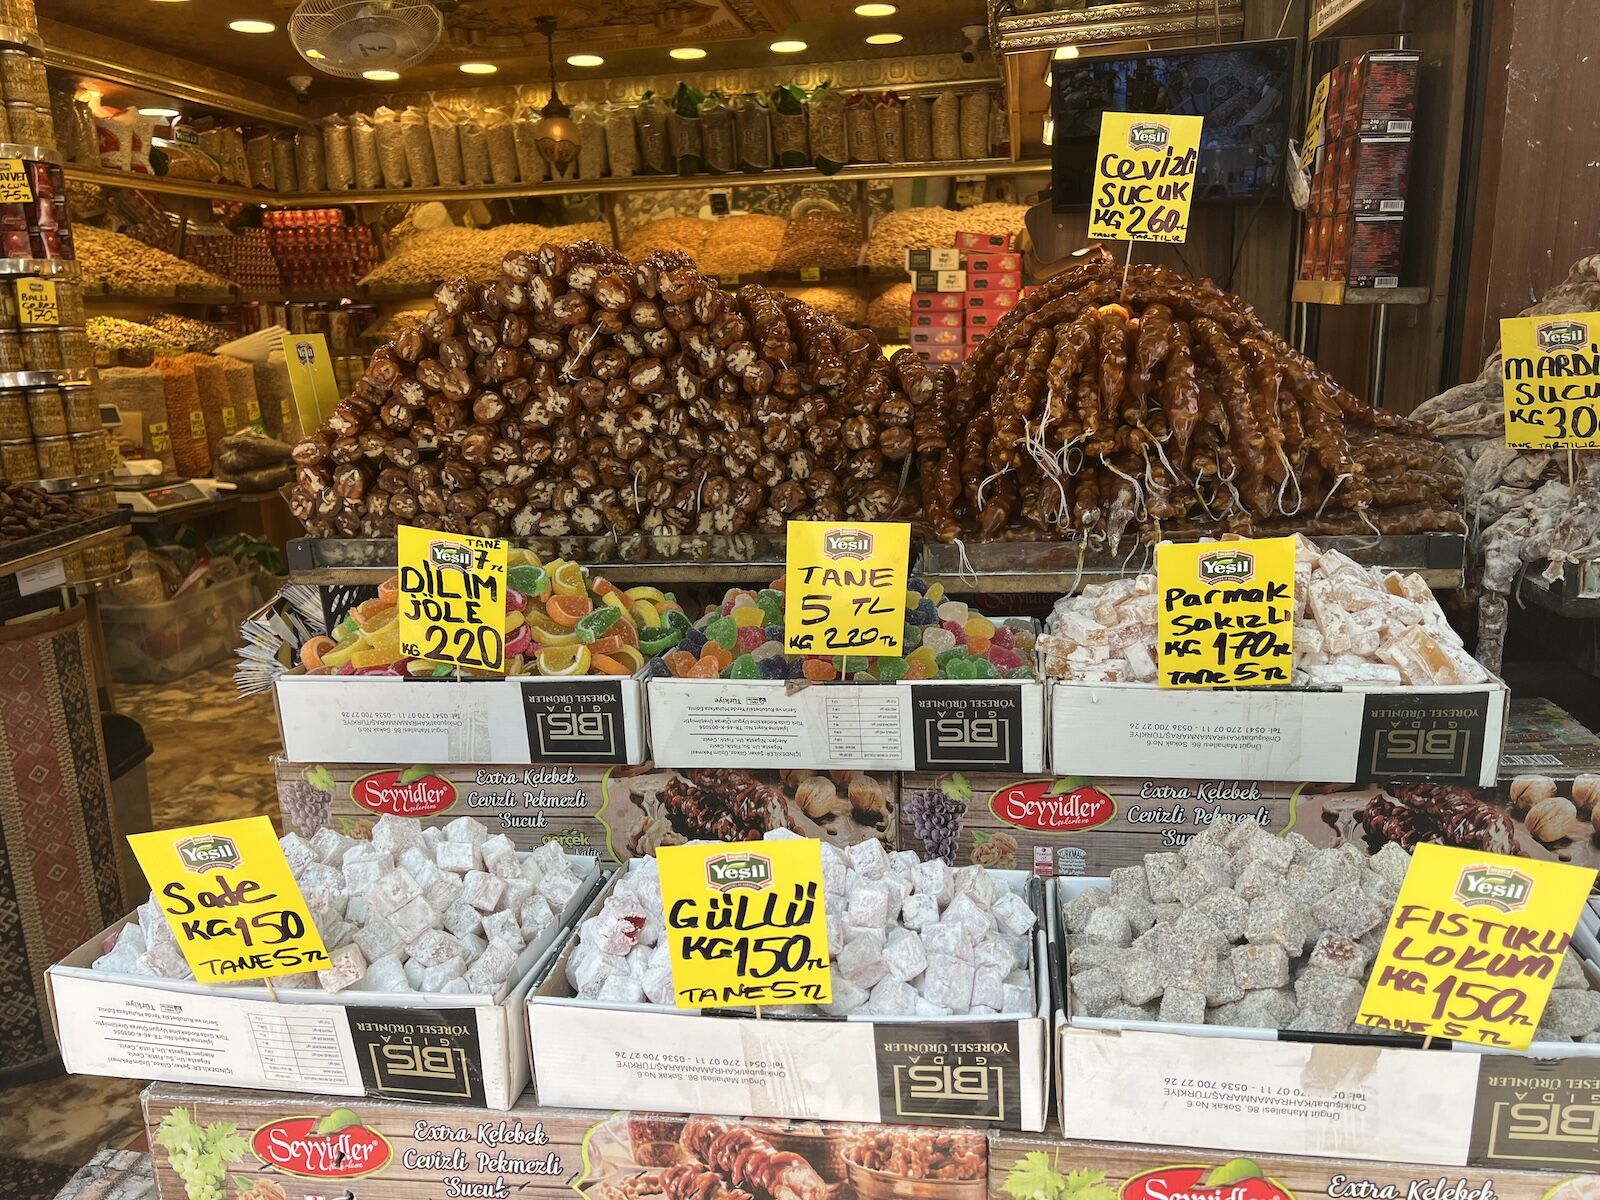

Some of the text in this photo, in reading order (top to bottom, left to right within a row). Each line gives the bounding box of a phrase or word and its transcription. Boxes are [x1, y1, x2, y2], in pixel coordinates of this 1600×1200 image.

[1133, 129, 1166, 143] Yeşil
[1101, 146, 1196, 180] Cevizli
[1094, 209, 1124, 229] KG
[1541, 330, 1582, 343] Yeşil
[1509, 406, 1600, 438] KG 30
[465, 539, 501, 549] TANE
[828, 537, 868, 551] Yeşil
[433, 547, 469, 564] Yeşil
[474, 550, 490, 569] 7
[798, 566, 894, 587] TANE
[1204, 561, 1249, 575] Yeşil
[801, 594, 895, 625] 5 TL
[402, 625, 502, 669] KG 220
[789, 635, 814, 650] KG
[824, 627, 878, 648] 220
[1164, 640, 1201, 657] KG
[1234, 662, 1260, 680] 5
[575, 694, 616, 703] YÖRESEL
[969, 700, 1015, 708] YÖRESEL
[1429, 708, 1479, 719] YÖRESEL
[547, 713, 604, 740] BTS
[937, 719, 998, 747] BTS
[1386, 730, 1457, 759] BTS
[476, 767, 577, 788] Extra Kelebek
[365, 781, 444, 812] Seyyidler
[468, 789, 588, 808] Cevizli Pekmezli
[1140, 780, 1262, 804] Extra Kelebek
[1007, 791, 1100, 826] Seyyidler
[1127, 804, 1186, 824] Cevizli
[498, 810, 548, 828] Sucuk
[184, 844, 233, 862] Yeşil
[711, 864, 766, 880] Yeşil
[163, 875, 278, 915] Sade
[1466, 874, 1526, 899] Yeşil
[669, 881, 818, 930] GÜLLÜ
[1392, 937, 1555, 980] LOKUM
[1378, 966, 1428, 995] KG
[417, 1025, 470, 1036] YÖRESEL
[380, 1035, 450, 1046] GIDA
[951, 1043, 1010, 1054] YÖRESEL
[382, 1044, 456, 1079] BTS
[615, 1051, 626, 1059] 26
[663, 1054, 685, 1063] 0536
[709, 1058, 720, 1066] 07
[908, 1056, 987, 1065] GIDA
[908, 1065, 988, 1100] BTS
[1164, 1077, 1178, 1086] 26
[1182, 1078, 1194, 1087] 27
[1198, 1080, 1217, 1089] 700
[1221, 1082, 1248, 1092] 0536
[1276, 1088, 1289, 1096] 07
[1509, 1103, 1600, 1143] BTS
[413, 1120, 549, 1147] Extra Kelebek
[403, 1148, 563, 1176] Cevizli Pekmezli
[1327, 1174, 1401, 1199] Extra
